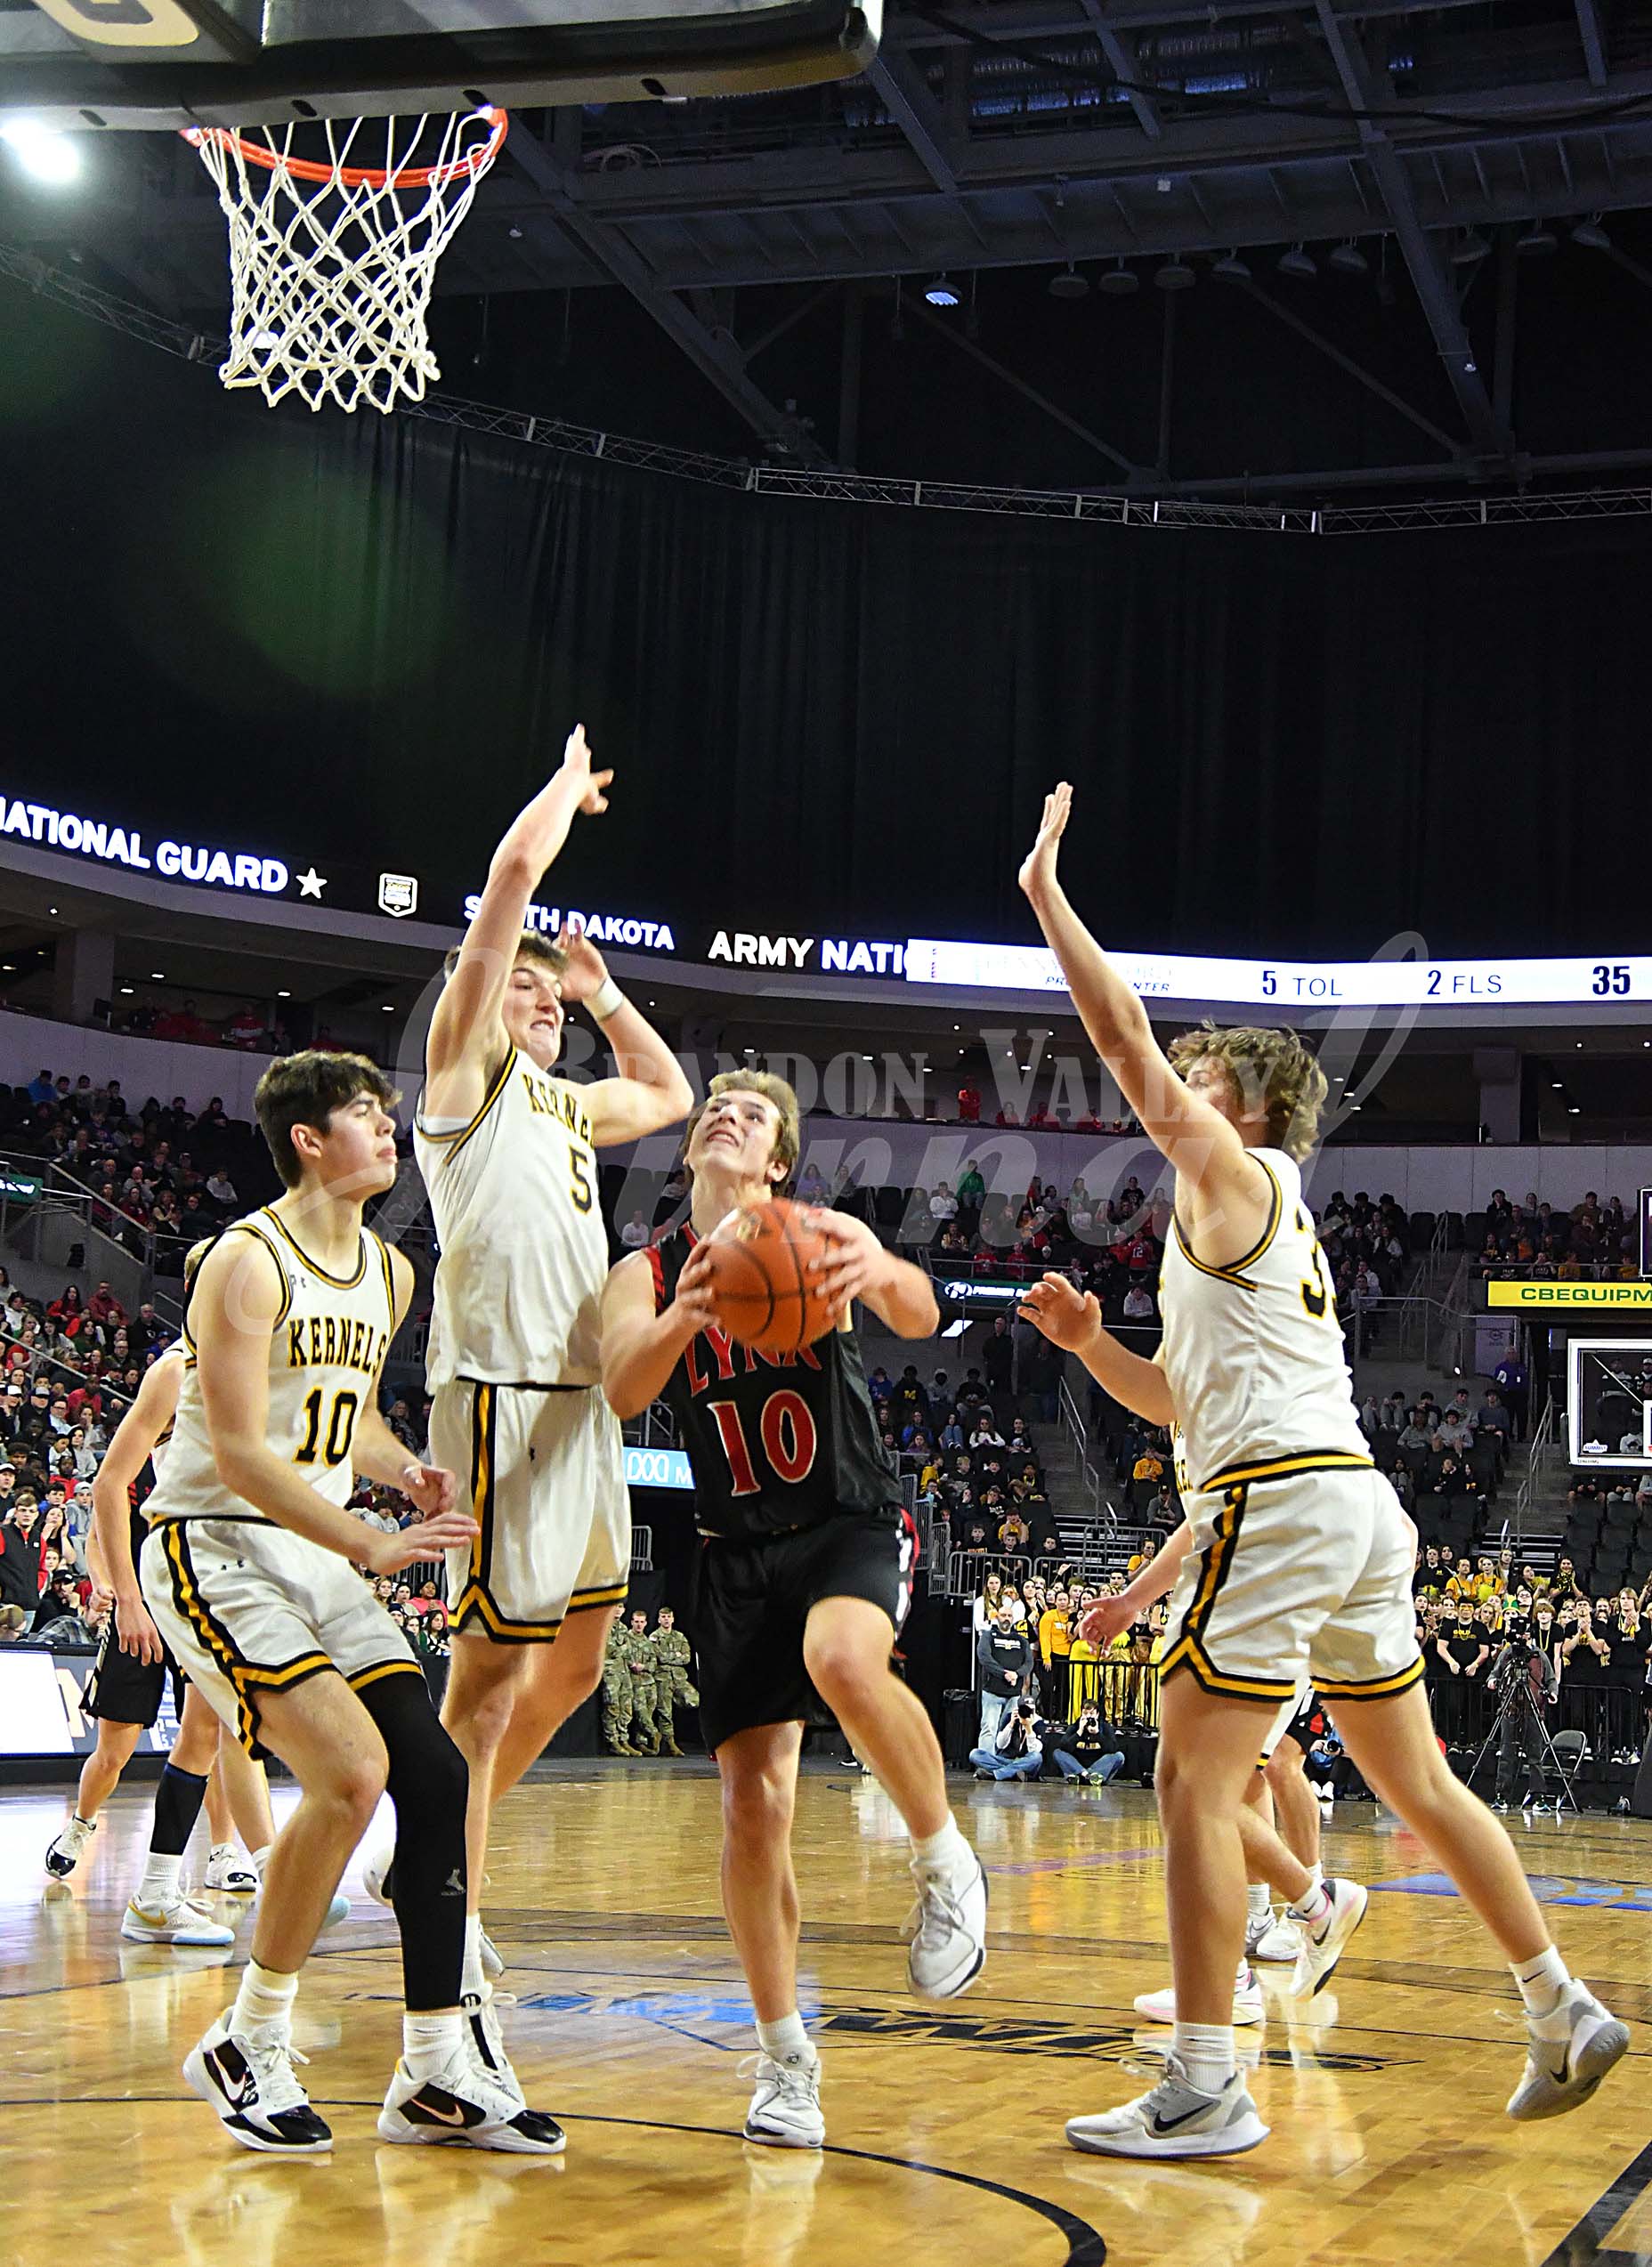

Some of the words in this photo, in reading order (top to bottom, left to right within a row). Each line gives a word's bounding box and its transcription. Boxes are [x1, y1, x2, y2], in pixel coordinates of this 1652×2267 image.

[0, 796, 151, 870] ATIONAL
[156, 840, 289, 893] GUARD
[464, 895, 561, 933] STH
[567, 910, 676, 951] DAKOTA
[708, 930, 814, 968] ARMY
[822, 939, 909, 975] NATI
[1262, 969, 1277, 996] 5
[1292, 976, 1344, 997] TOL
[1427, 969, 1441, 995] 2
[1453, 975, 1502, 995] FLS
[1591, 965, 1632, 995] 35
[570, 1142, 593, 1217] 5
[1296, 1204, 1340, 1322] 3
[287, 1316, 389, 1379] KERNELS
[291, 1385, 359, 1468] 10
[707, 1389, 818, 1497] 10
